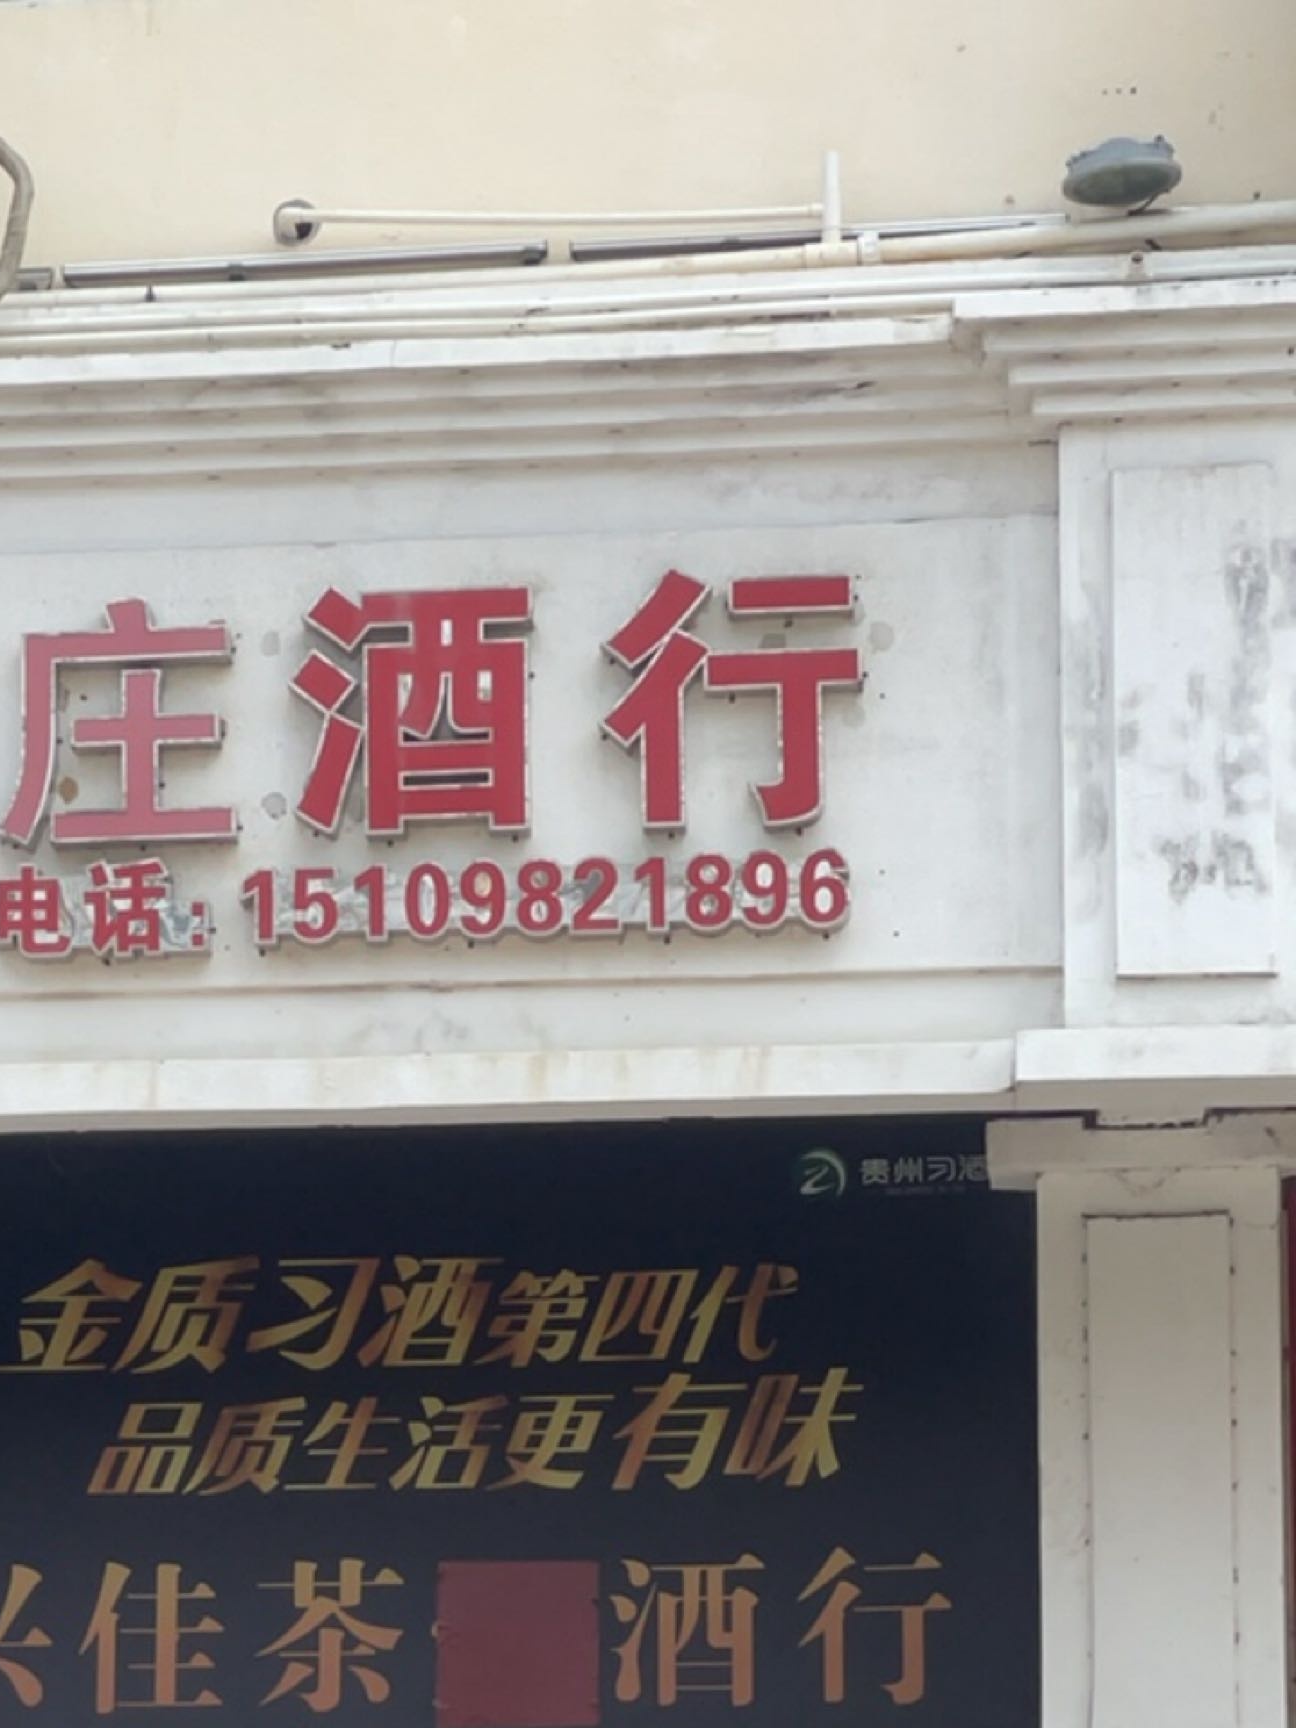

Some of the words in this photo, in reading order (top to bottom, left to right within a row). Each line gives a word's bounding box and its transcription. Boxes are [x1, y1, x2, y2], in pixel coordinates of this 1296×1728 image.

[86, 1366, 864, 1497] 品质生活更有味
